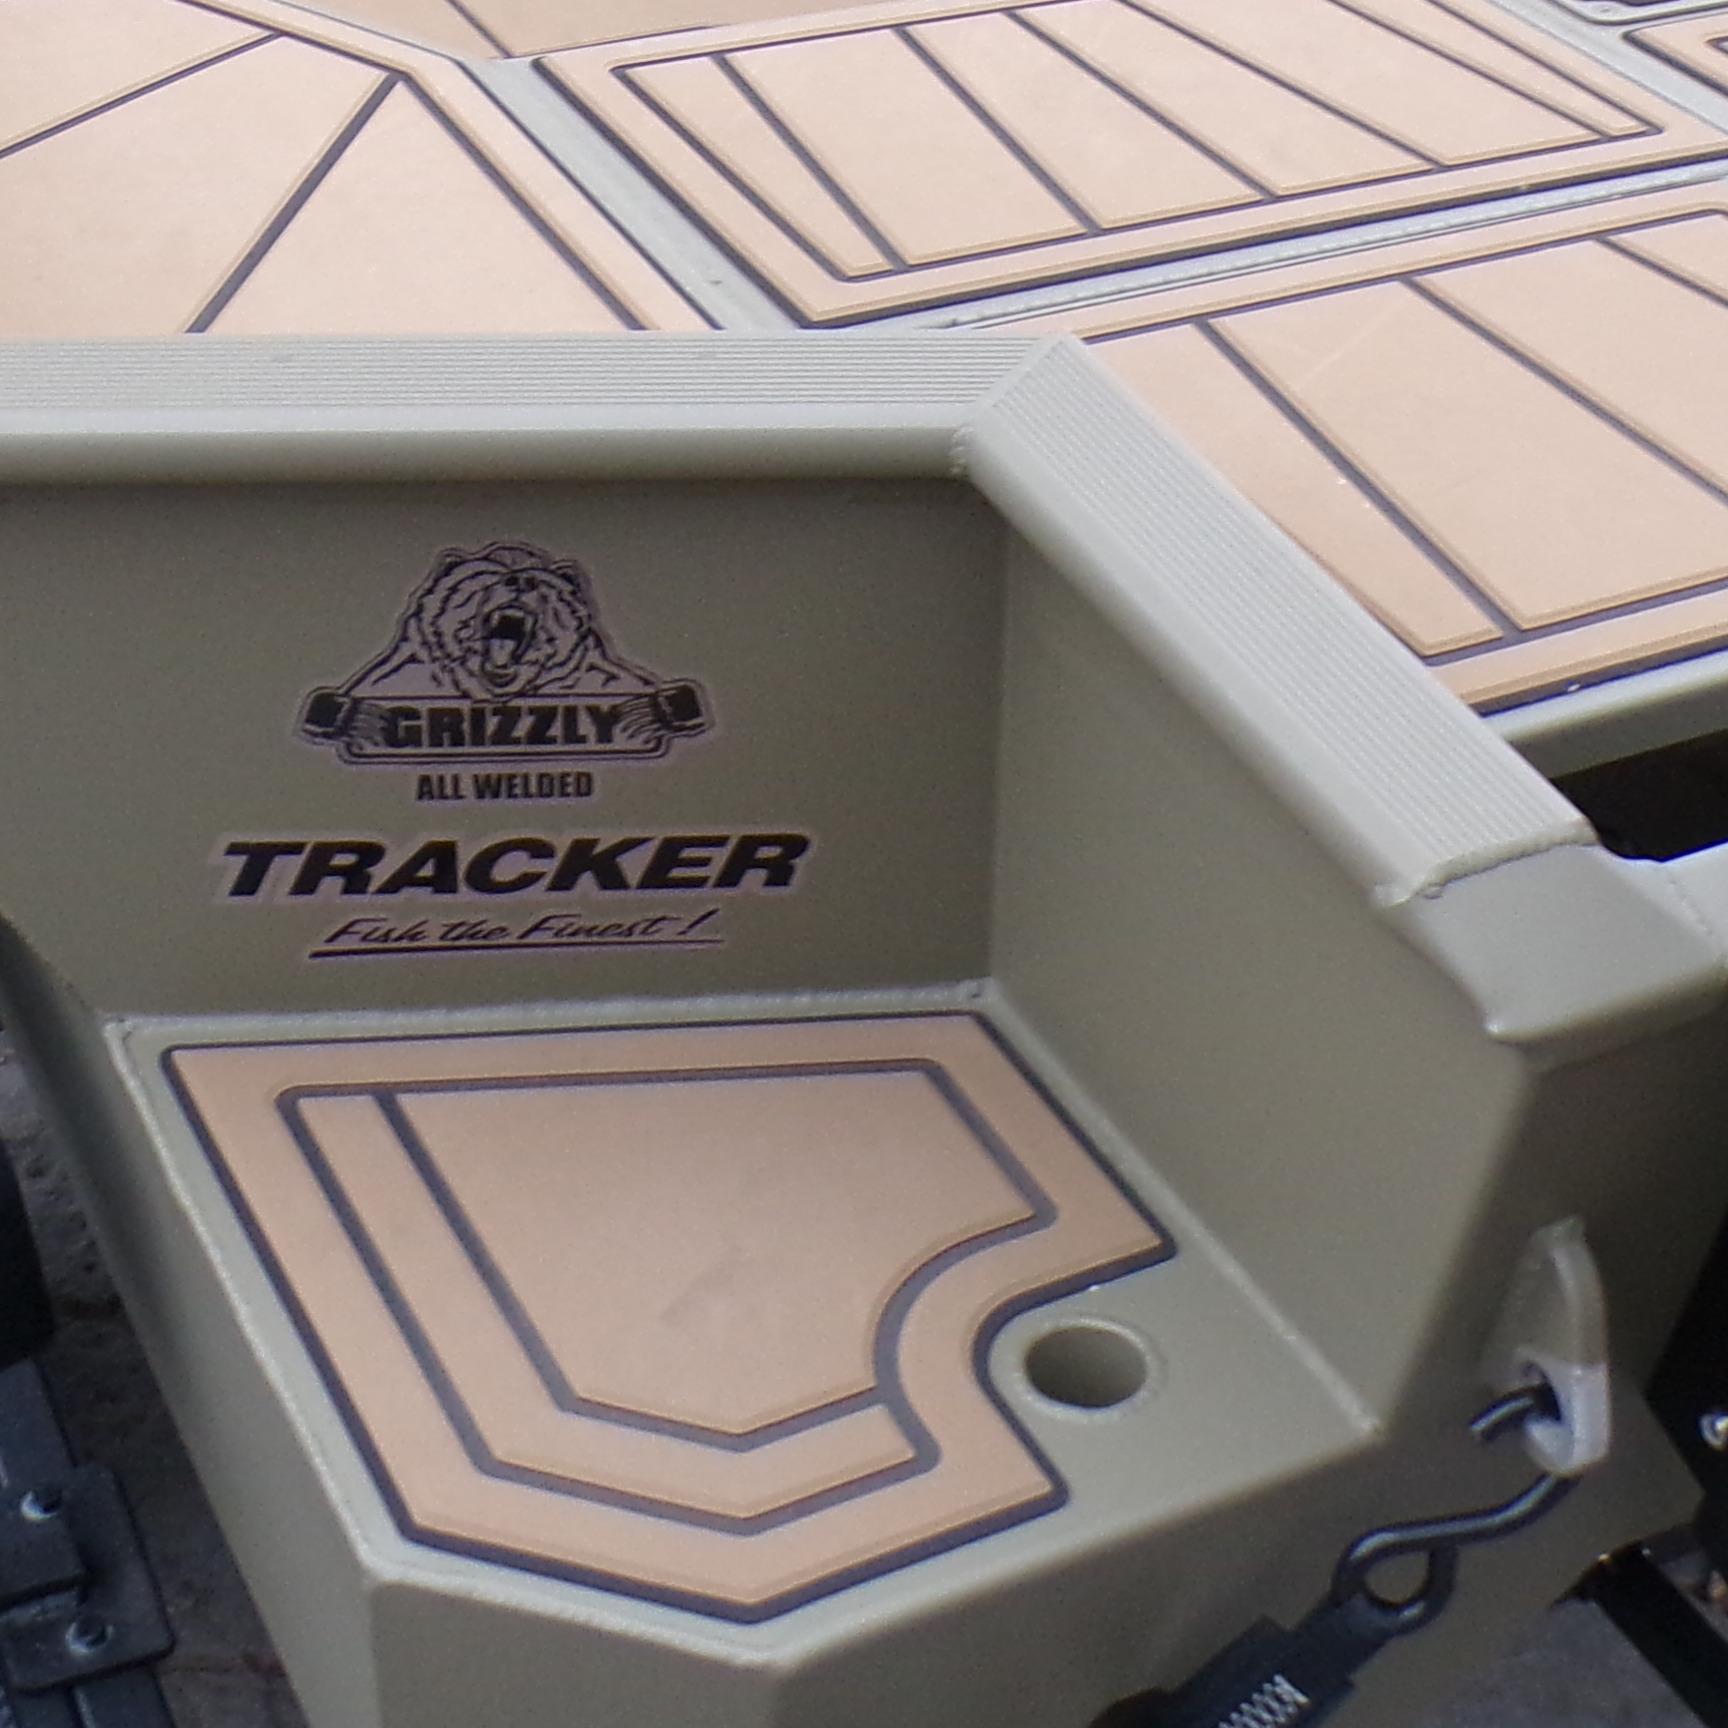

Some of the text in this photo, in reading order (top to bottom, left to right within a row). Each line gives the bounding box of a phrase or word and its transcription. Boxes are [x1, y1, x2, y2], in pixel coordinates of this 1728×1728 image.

[380, 704, 622, 749] GRIZZLY
[416, 771, 593, 802] ALL WELDED
[221, 832, 812, 898] TRACKER
[324, 917, 427, 944] Fish
[438, 919, 509, 941] the
